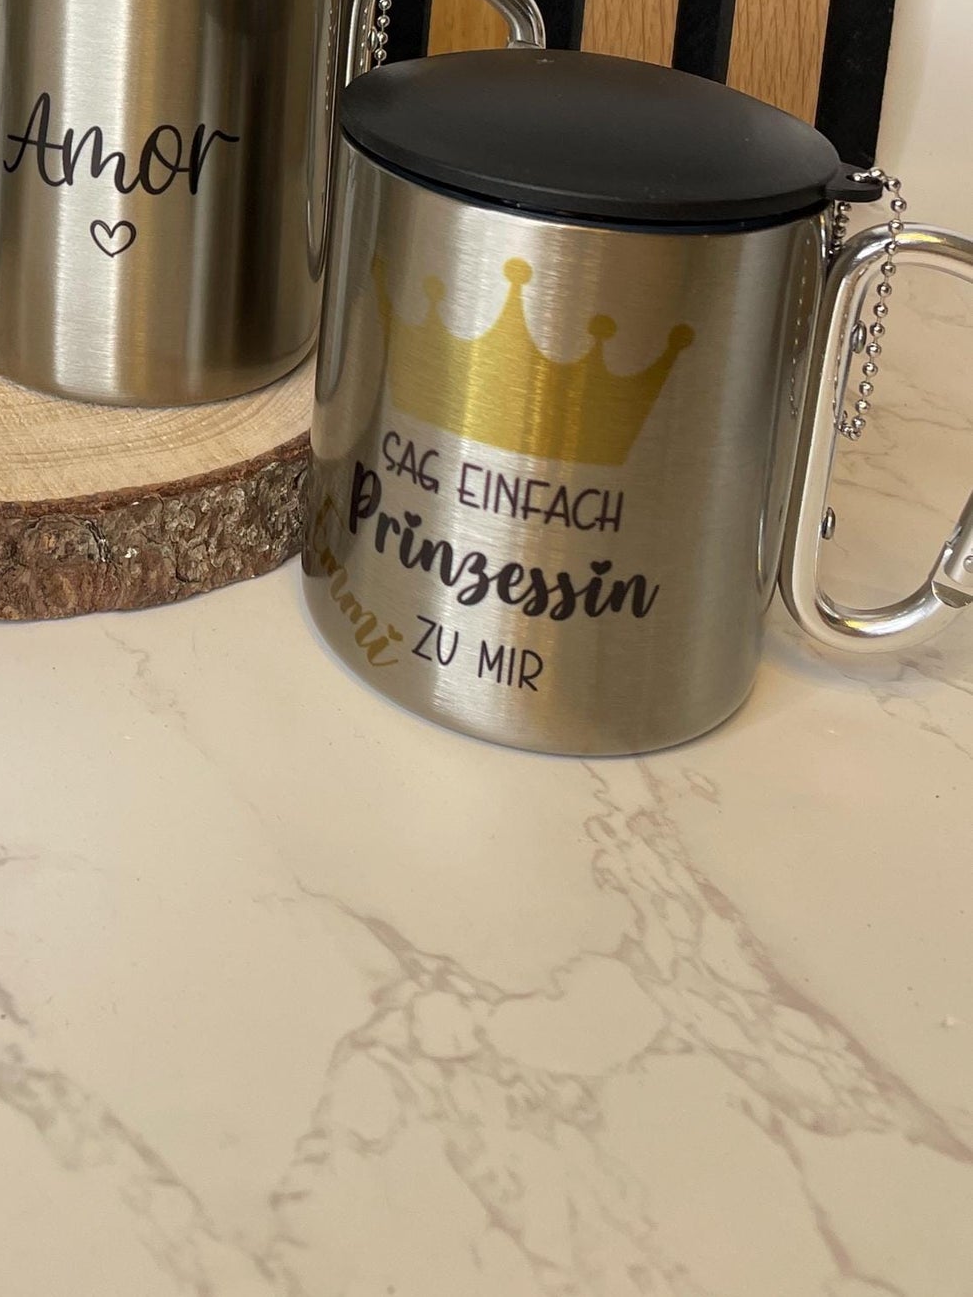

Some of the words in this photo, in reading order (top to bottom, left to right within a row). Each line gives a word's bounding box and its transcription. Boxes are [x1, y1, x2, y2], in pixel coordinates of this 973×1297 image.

[3, 92, 240, 195] Amor
[382, 430, 439, 495] SAG
[457, 462, 625, 533] EINFACH
[349, 461, 661, 621] Prinzessin
[411, 614, 460, 667] ZU
[477, 639, 544, 692] MIR
